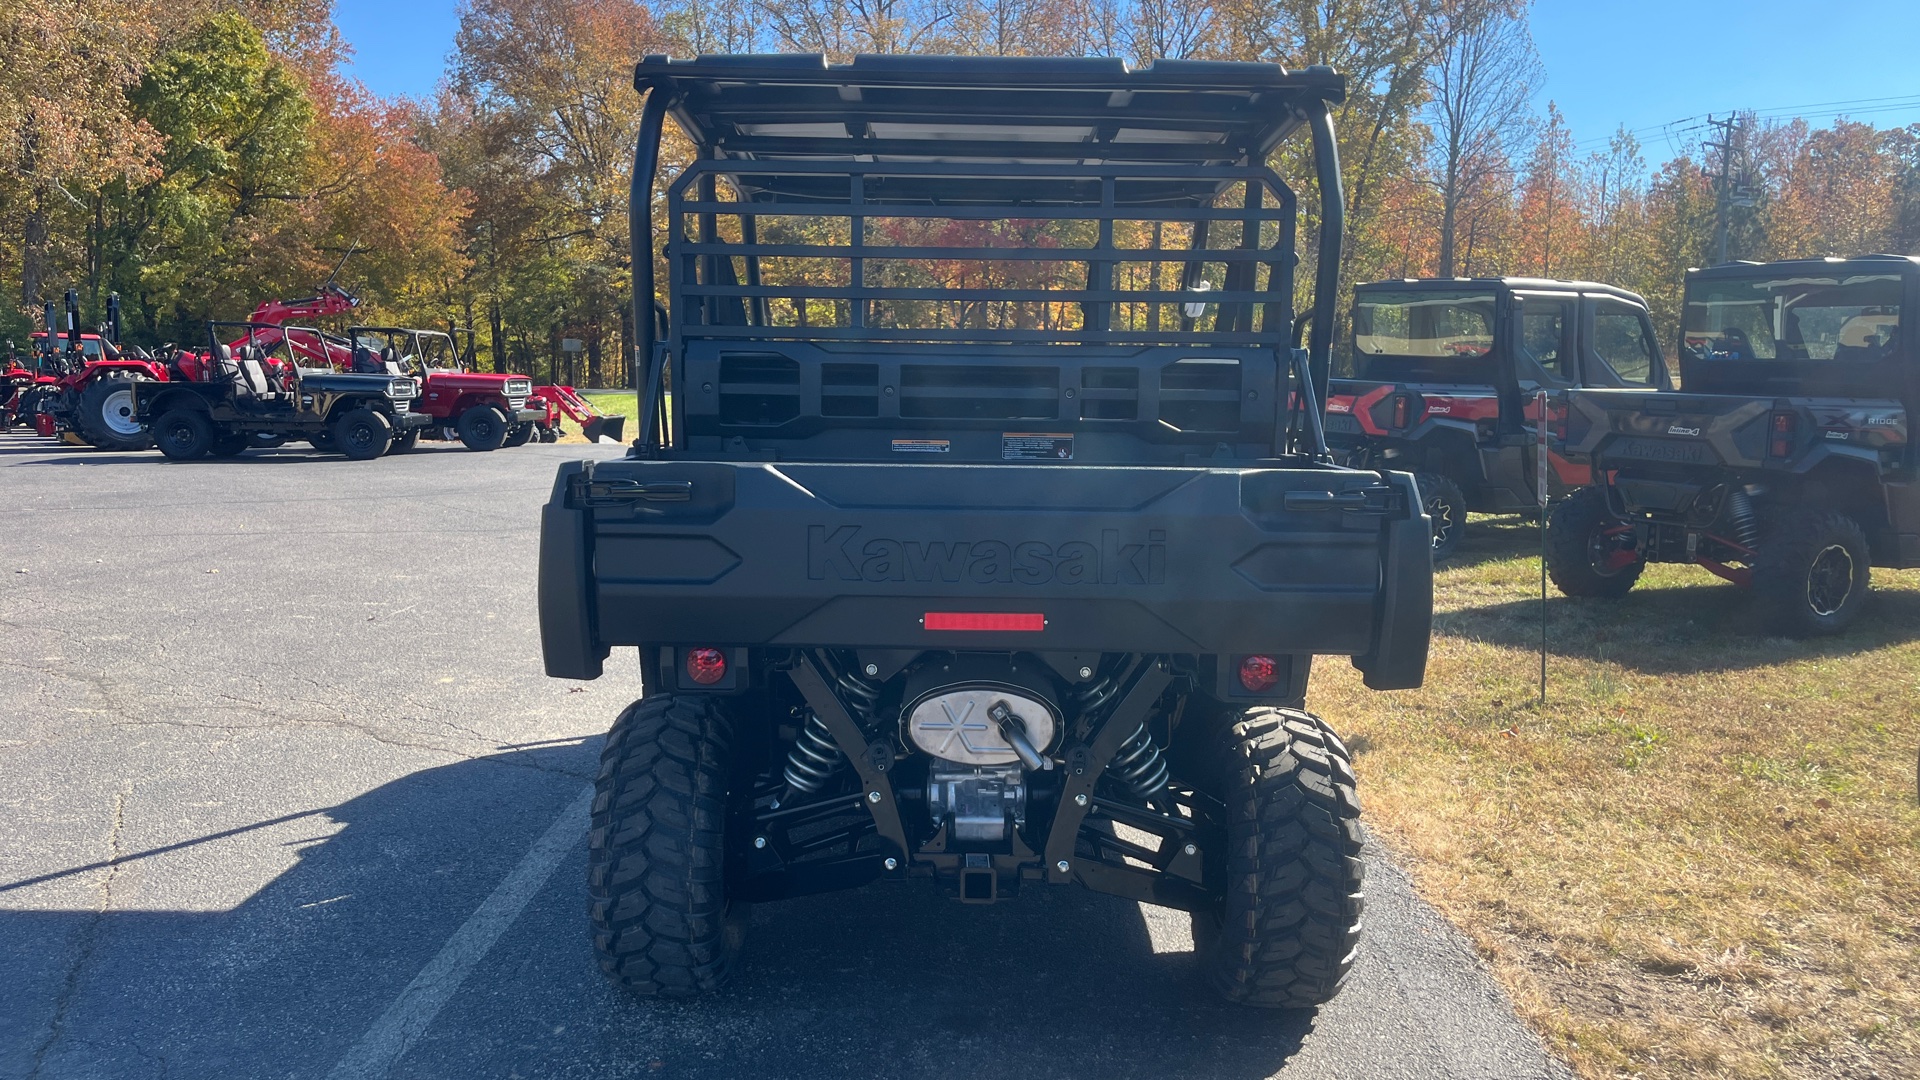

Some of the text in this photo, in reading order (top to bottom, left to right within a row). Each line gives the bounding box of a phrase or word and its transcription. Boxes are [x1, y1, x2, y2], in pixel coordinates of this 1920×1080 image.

[1868, 417, 1899, 425] RIDGE
[1668, 425, 1700, 436] Inline-4
[1622, 440, 1704, 461] Kawasaki
[807, 524, 1167, 585] Kawasaki
